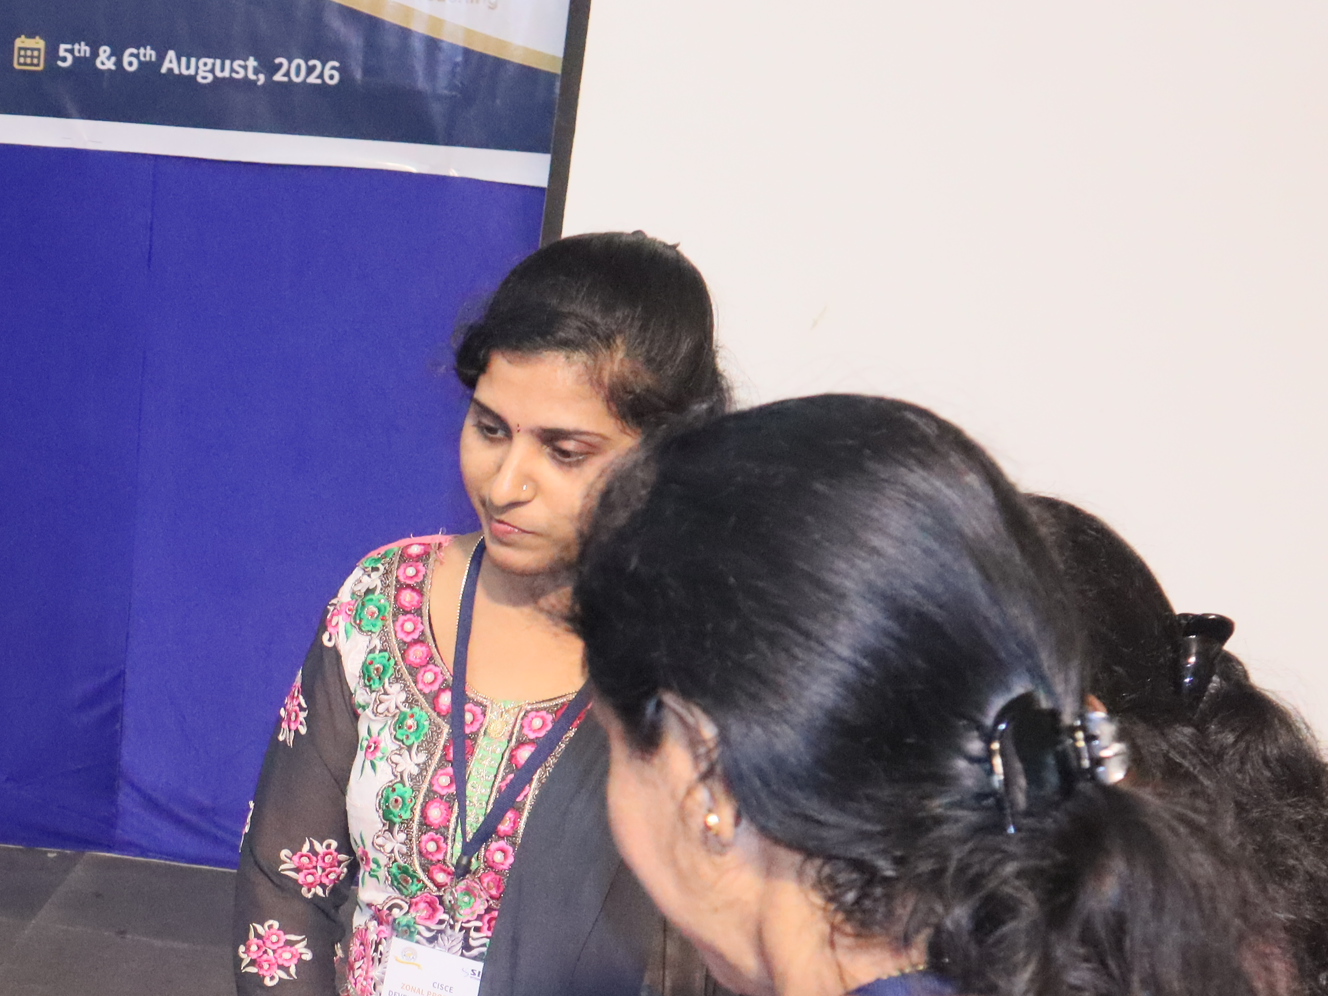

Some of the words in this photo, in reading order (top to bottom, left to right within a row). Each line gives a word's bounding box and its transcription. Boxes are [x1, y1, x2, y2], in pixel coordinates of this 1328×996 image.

[56, 41, 90, 68] 5th
[95, 45, 117, 71] &
[122, 45, 156, 72] 6th
[160, 50, 266, 85] August,
[272, 57, 340, 85] 2026
[400, 982, 425, 996] ZONAL
[432, 981, 454, 993] CISCE
